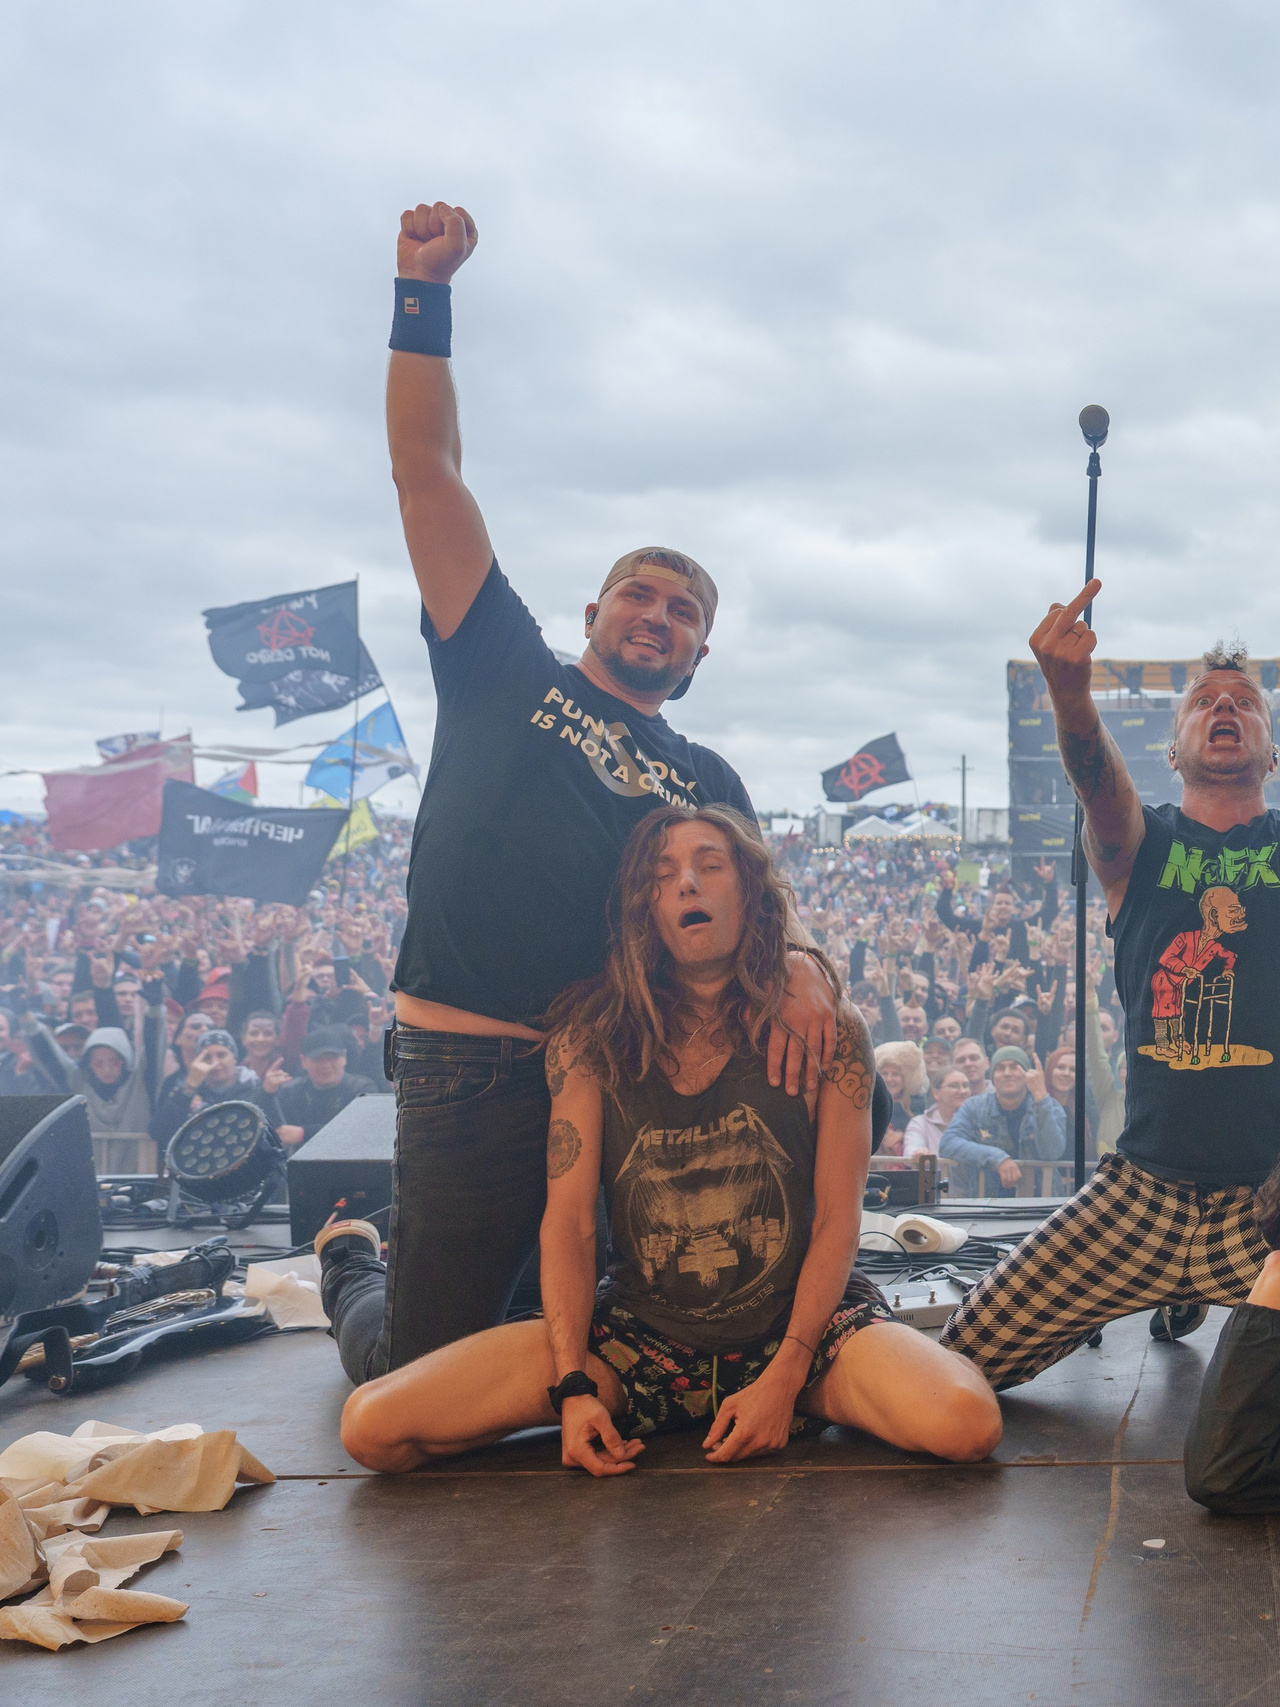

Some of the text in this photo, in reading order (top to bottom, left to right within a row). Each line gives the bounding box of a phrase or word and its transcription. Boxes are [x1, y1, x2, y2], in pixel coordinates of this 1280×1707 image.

[530, 709, 557, 730] IS
[559, 724, 612, 766] NOT
[611, 764, 630, 784] A
[543, 686, 623, 752] PUNK
[614, 1102, 795, 1183] METALLICA
